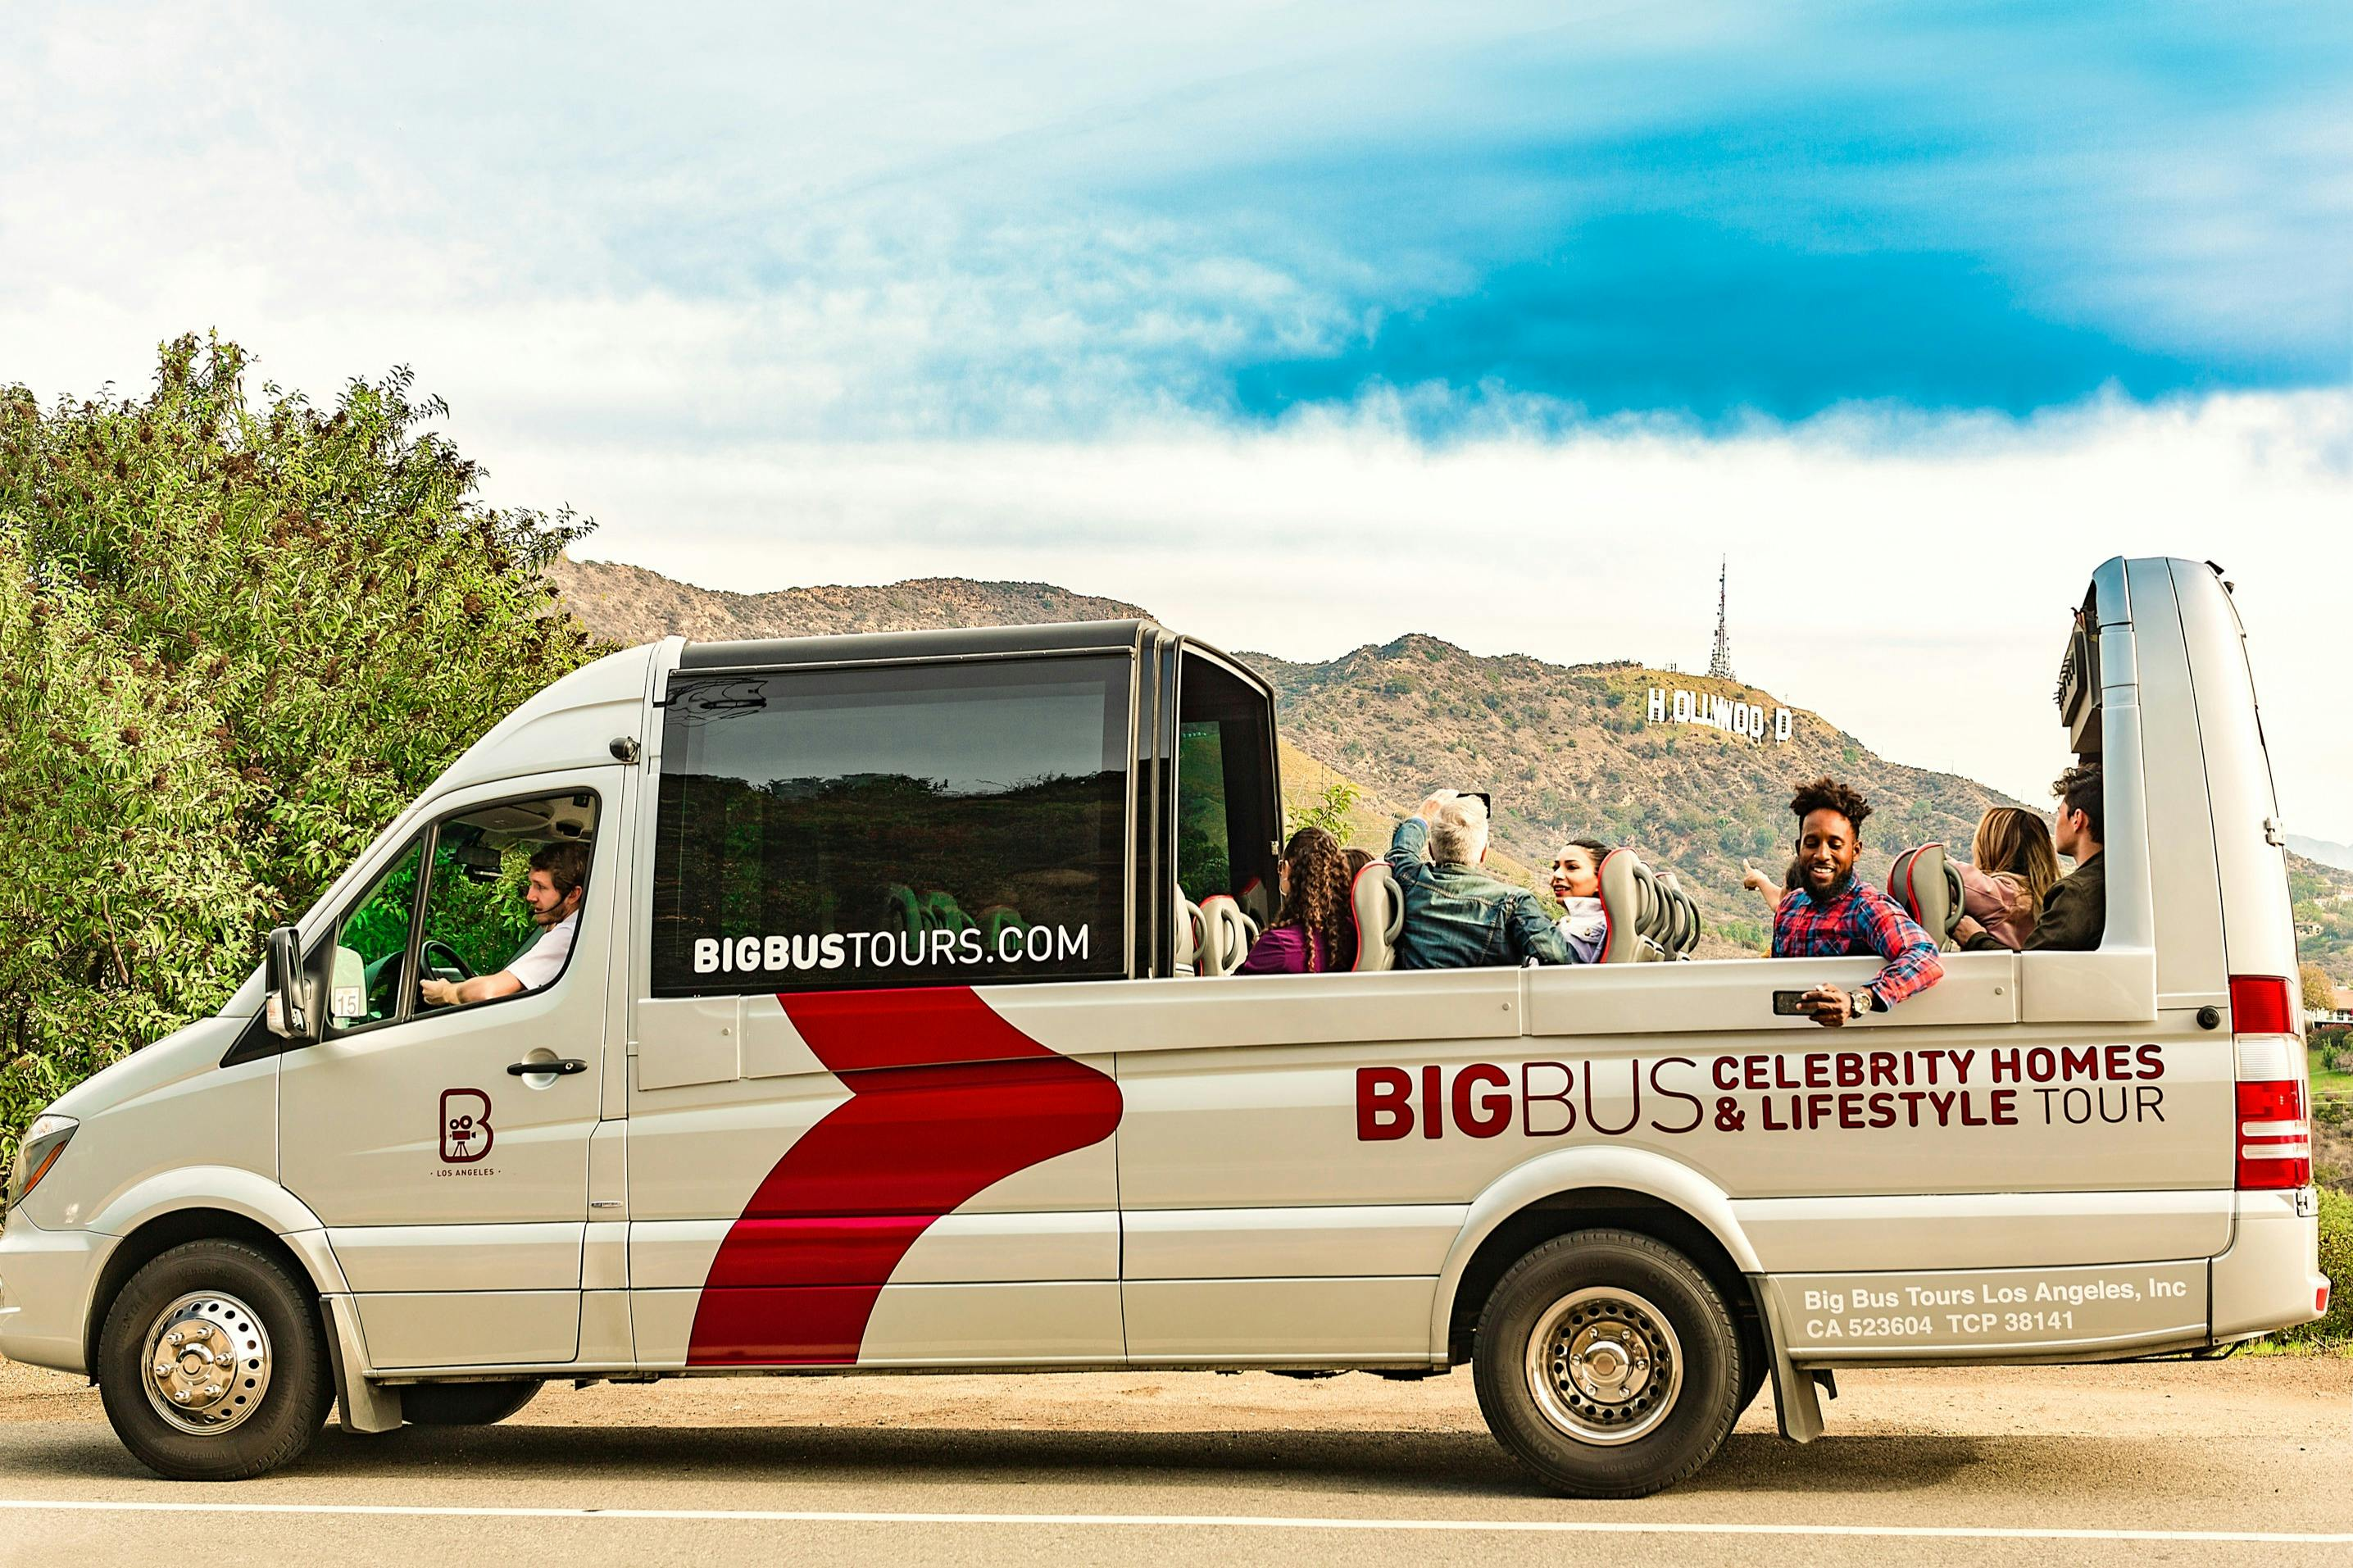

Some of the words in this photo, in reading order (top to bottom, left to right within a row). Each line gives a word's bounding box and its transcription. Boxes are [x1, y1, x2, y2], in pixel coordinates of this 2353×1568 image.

[693, 923, 1089, 974] BIGBUSTOURS.COM
[338, 995, 357, 1016] 15
[1711, 1048, 1976, 1092] CELEBRITY
[1990, 1043, 2165, 1084] HOMES
[1713, 1095, 1747, 1132] &
[1760, 1089, 2019, 1132] LIFESTYLE
[2032, 1084, 2166, 1125] TOUR
[437, 1169, 452, 1177] LOS
[455, 1168, 494, 1176] ANGELES
[1804, 1289, 1845, 1314] Big
[1851, 1288, 1900, 1308] Bus
[1905, 1286, 1975, 1307] Tours
[1982, 1284, 2028, 1304] Los
[2034, 1279, 2142, 1306] Angeles,
[2149, 1278, 2187, 1298] Inc
[1806, 1318, 1843, 1338] CA
[1848, 1316, 1933, 1337] 523604
[1946, 1313, 1997, 1334] TCP
[2005, 1311, 2074, 1332] 38141
